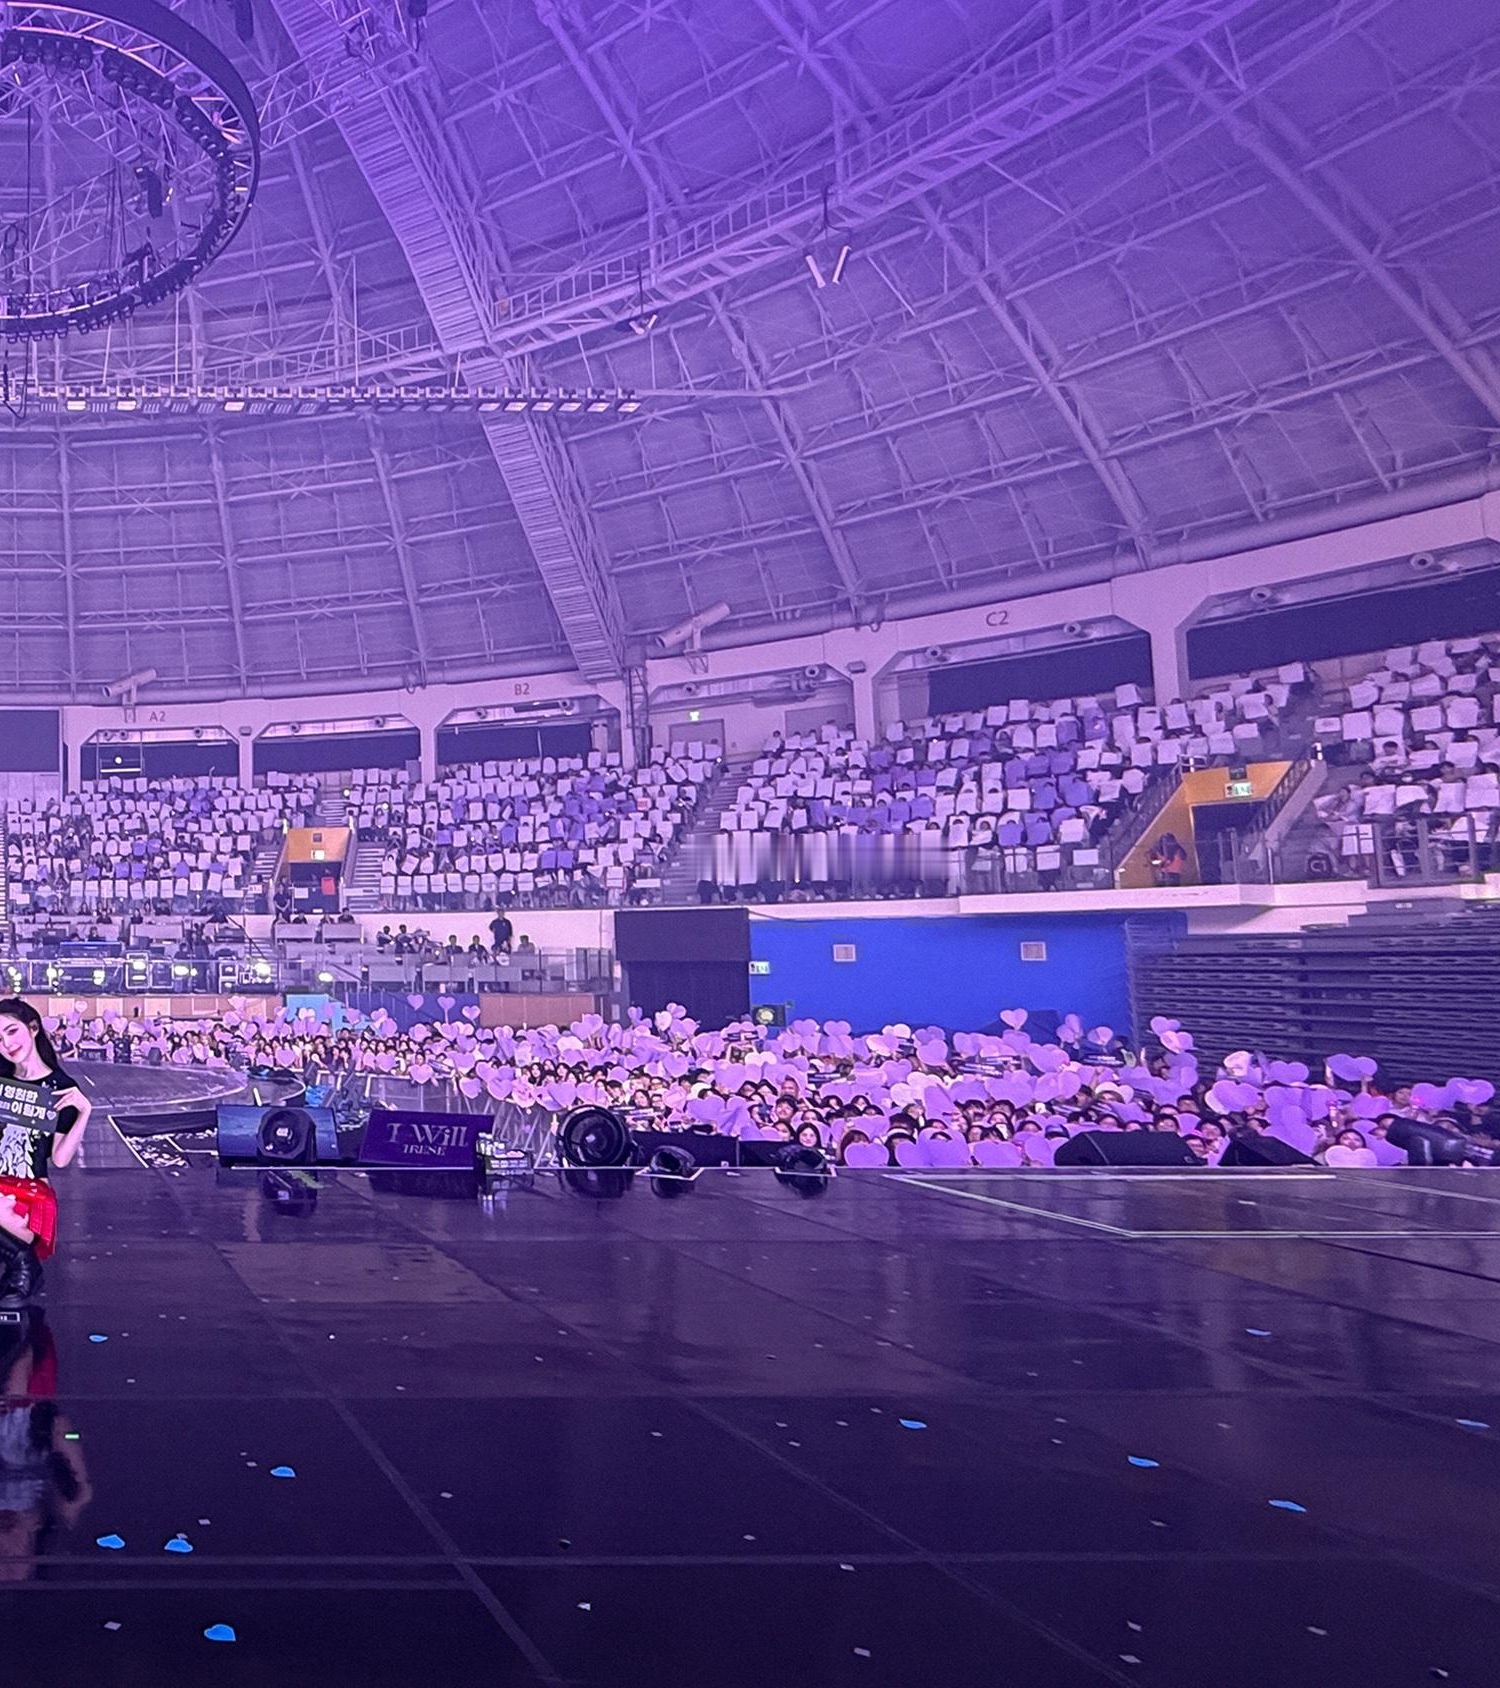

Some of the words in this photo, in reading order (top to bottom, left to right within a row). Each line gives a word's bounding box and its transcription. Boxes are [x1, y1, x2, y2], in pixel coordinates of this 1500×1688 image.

[985, 610, 1009, 627] C2
[514, 683, 531, 696] B2
[149, 711, 166, 722] A2
[387, 1123, 403, 1143] I
[410, 1124, 469, 1147] Will
[403, 1144, 446, 1156] IRENE
